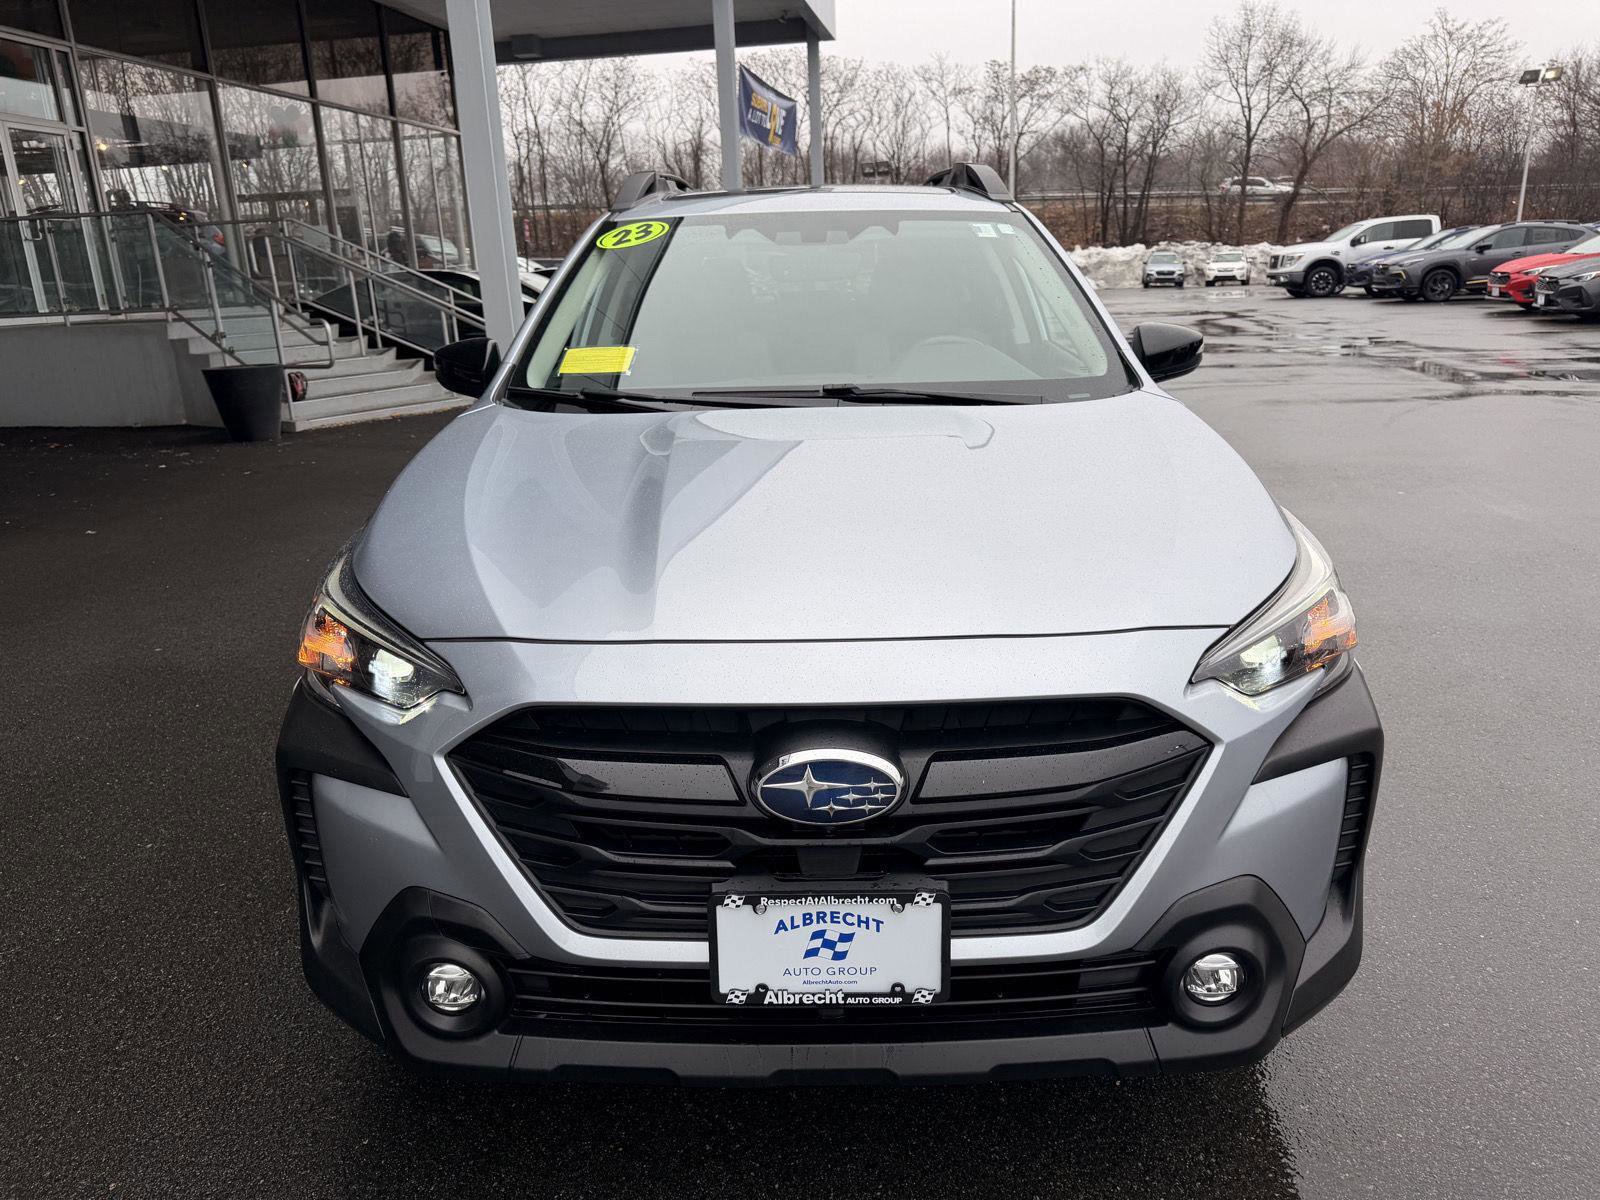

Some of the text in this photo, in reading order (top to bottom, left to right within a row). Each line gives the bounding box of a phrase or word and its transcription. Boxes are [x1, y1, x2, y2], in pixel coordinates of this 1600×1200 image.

[612, 223, 653, 246] 23
[760, 895, 897, 907] RespectAtAlbrecht.com
[774, 911, 884, 935] ALBRECHT
[783, 966, 877, 977] AUTO GROUP
[763, 989, 845, 1005] Albrecht
